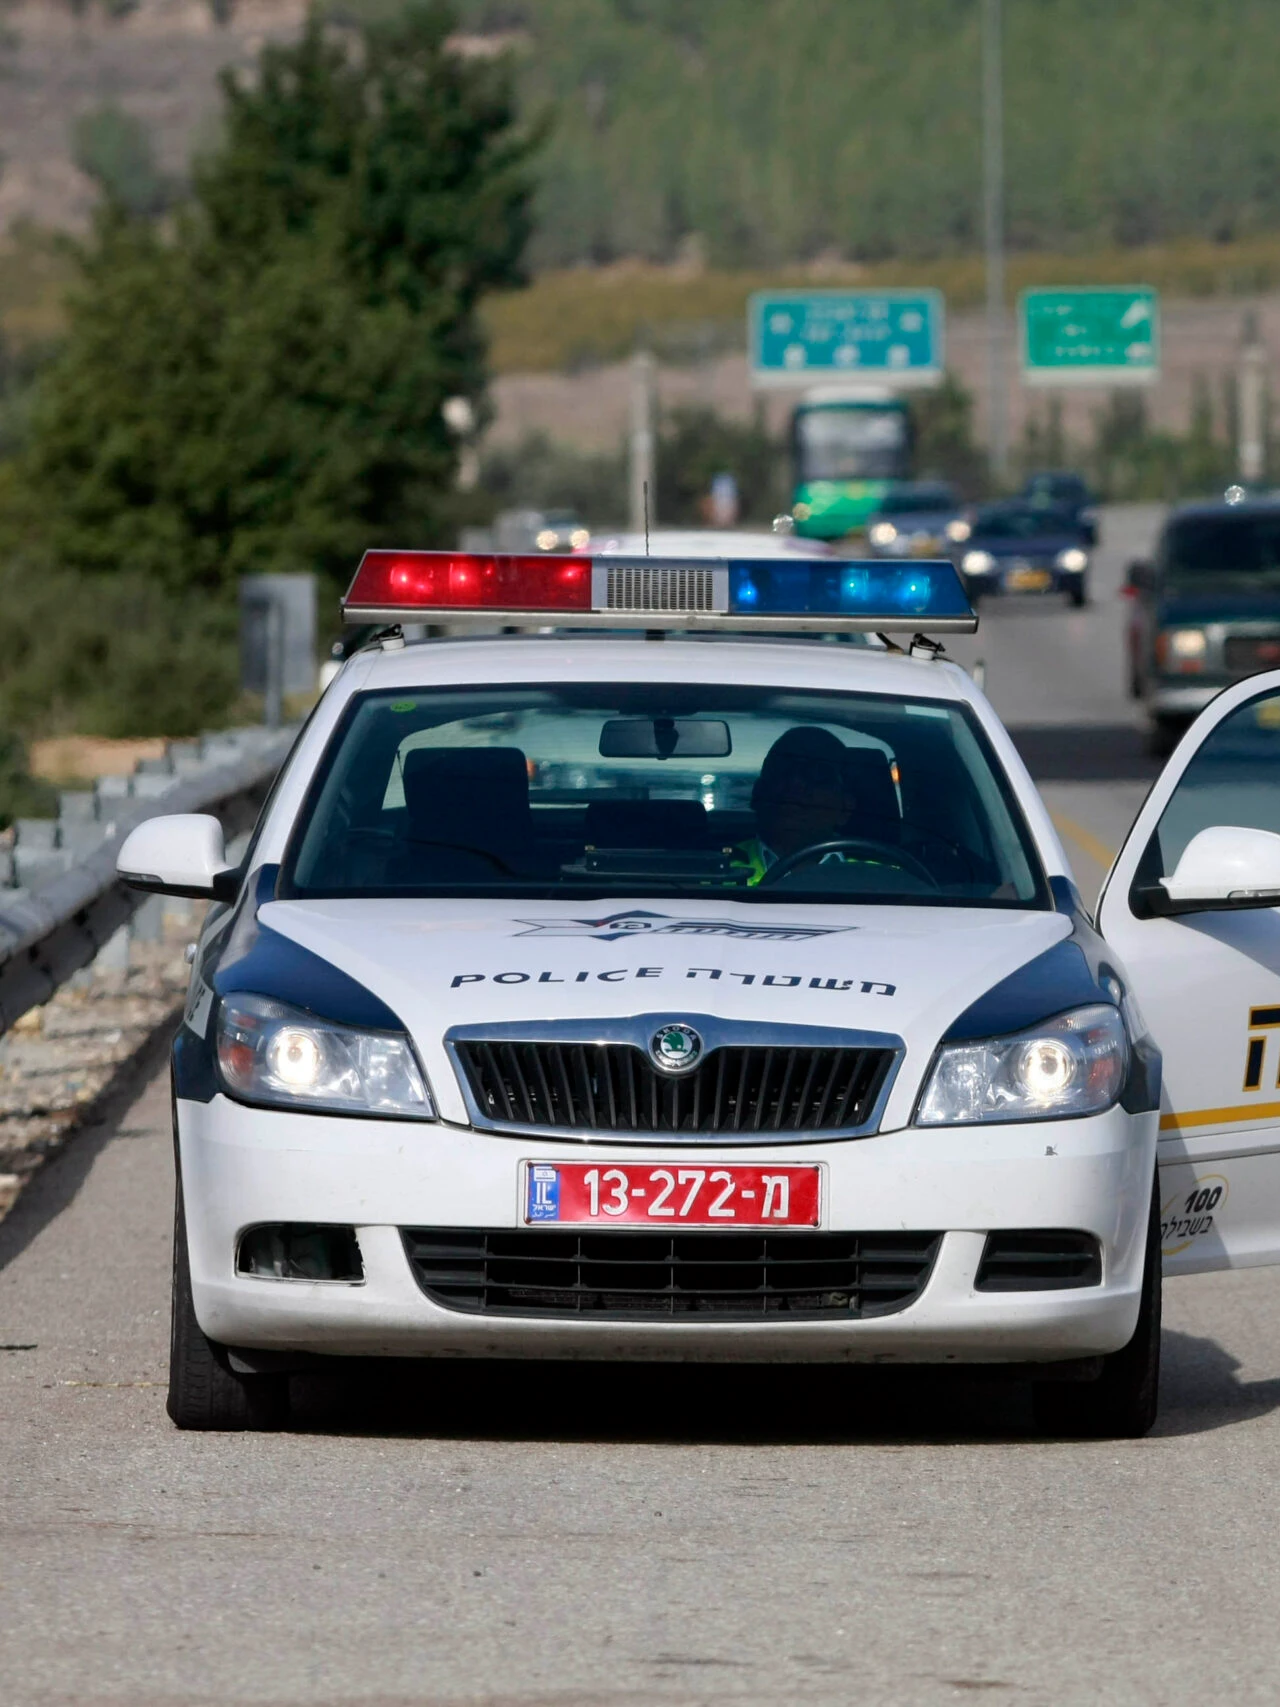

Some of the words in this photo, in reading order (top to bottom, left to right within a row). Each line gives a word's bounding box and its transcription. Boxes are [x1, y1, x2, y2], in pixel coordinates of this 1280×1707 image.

[450, 967, 664, 988] POLICE
[686, 967, 897, 997] משטרה
[536, 1182, 552, 1204] IL
[1185, 1186, 1222, 1213] 100
